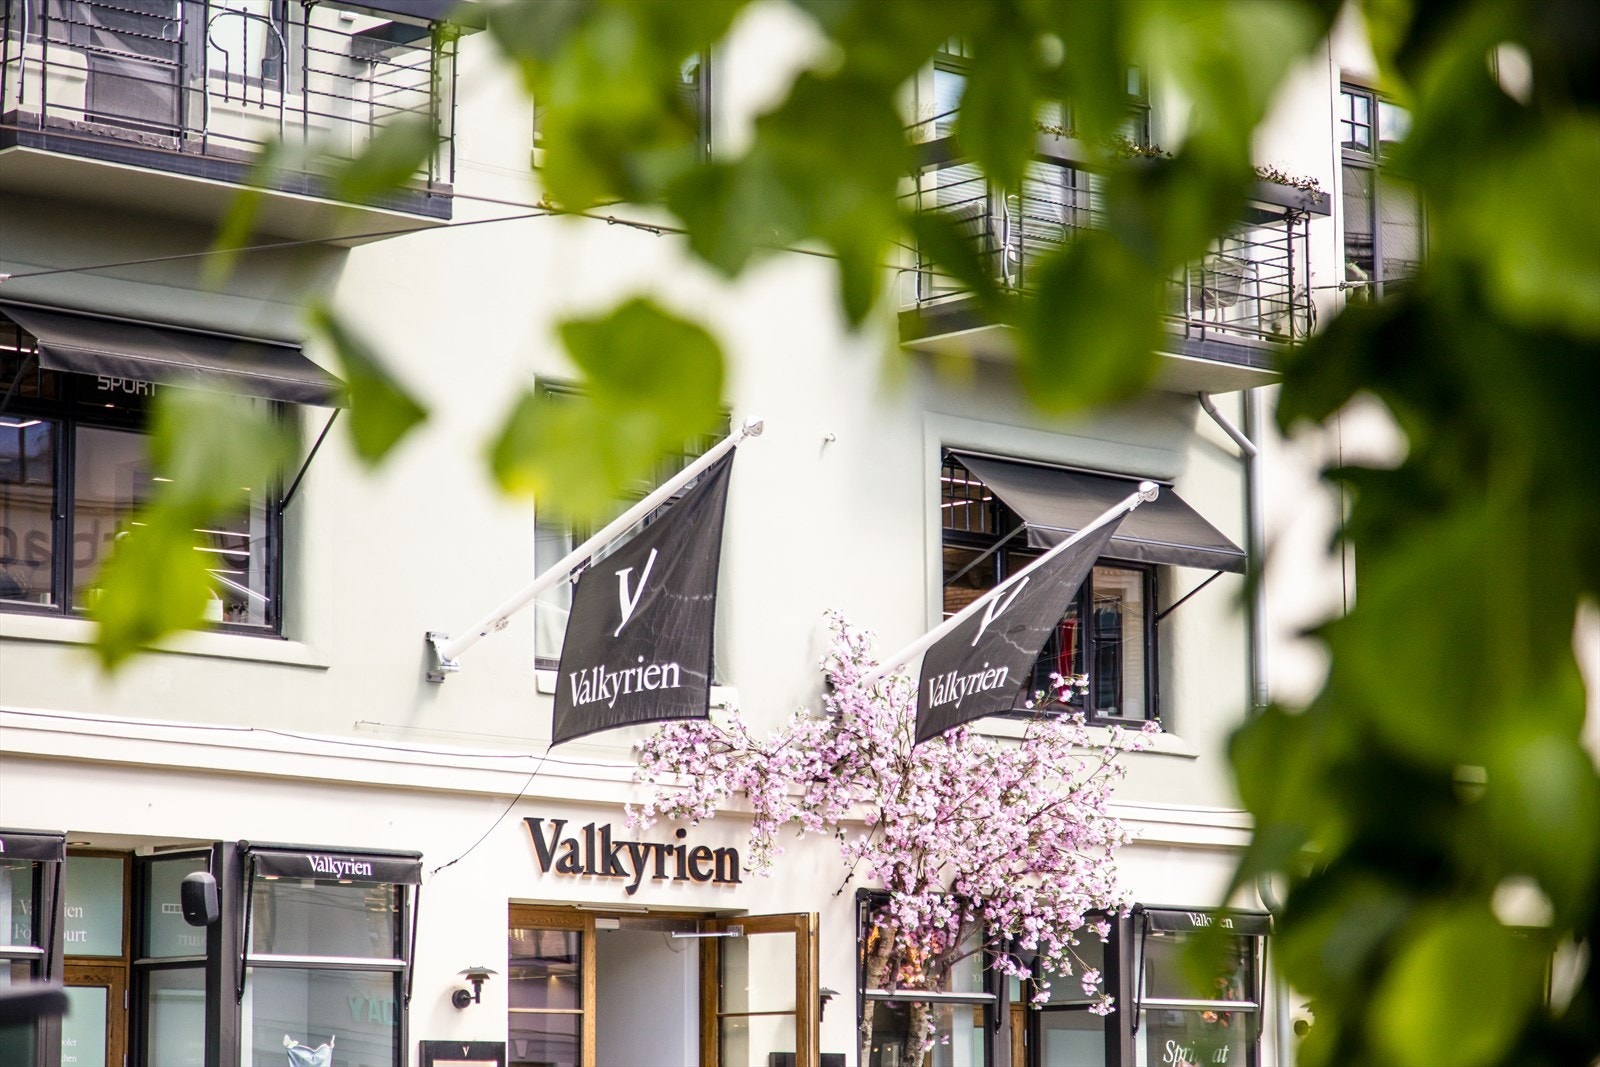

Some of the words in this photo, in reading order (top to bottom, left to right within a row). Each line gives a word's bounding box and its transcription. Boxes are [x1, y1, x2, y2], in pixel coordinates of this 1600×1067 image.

[569, 655, 681, 709] Valkyrien
[928, 661, 1009, 709] Valkyrien
[306, 854, 373, 878] Valkyrien
[523, 816, 743, 896] Valkyrien
[1186, 912, 1233, 929] Valken
